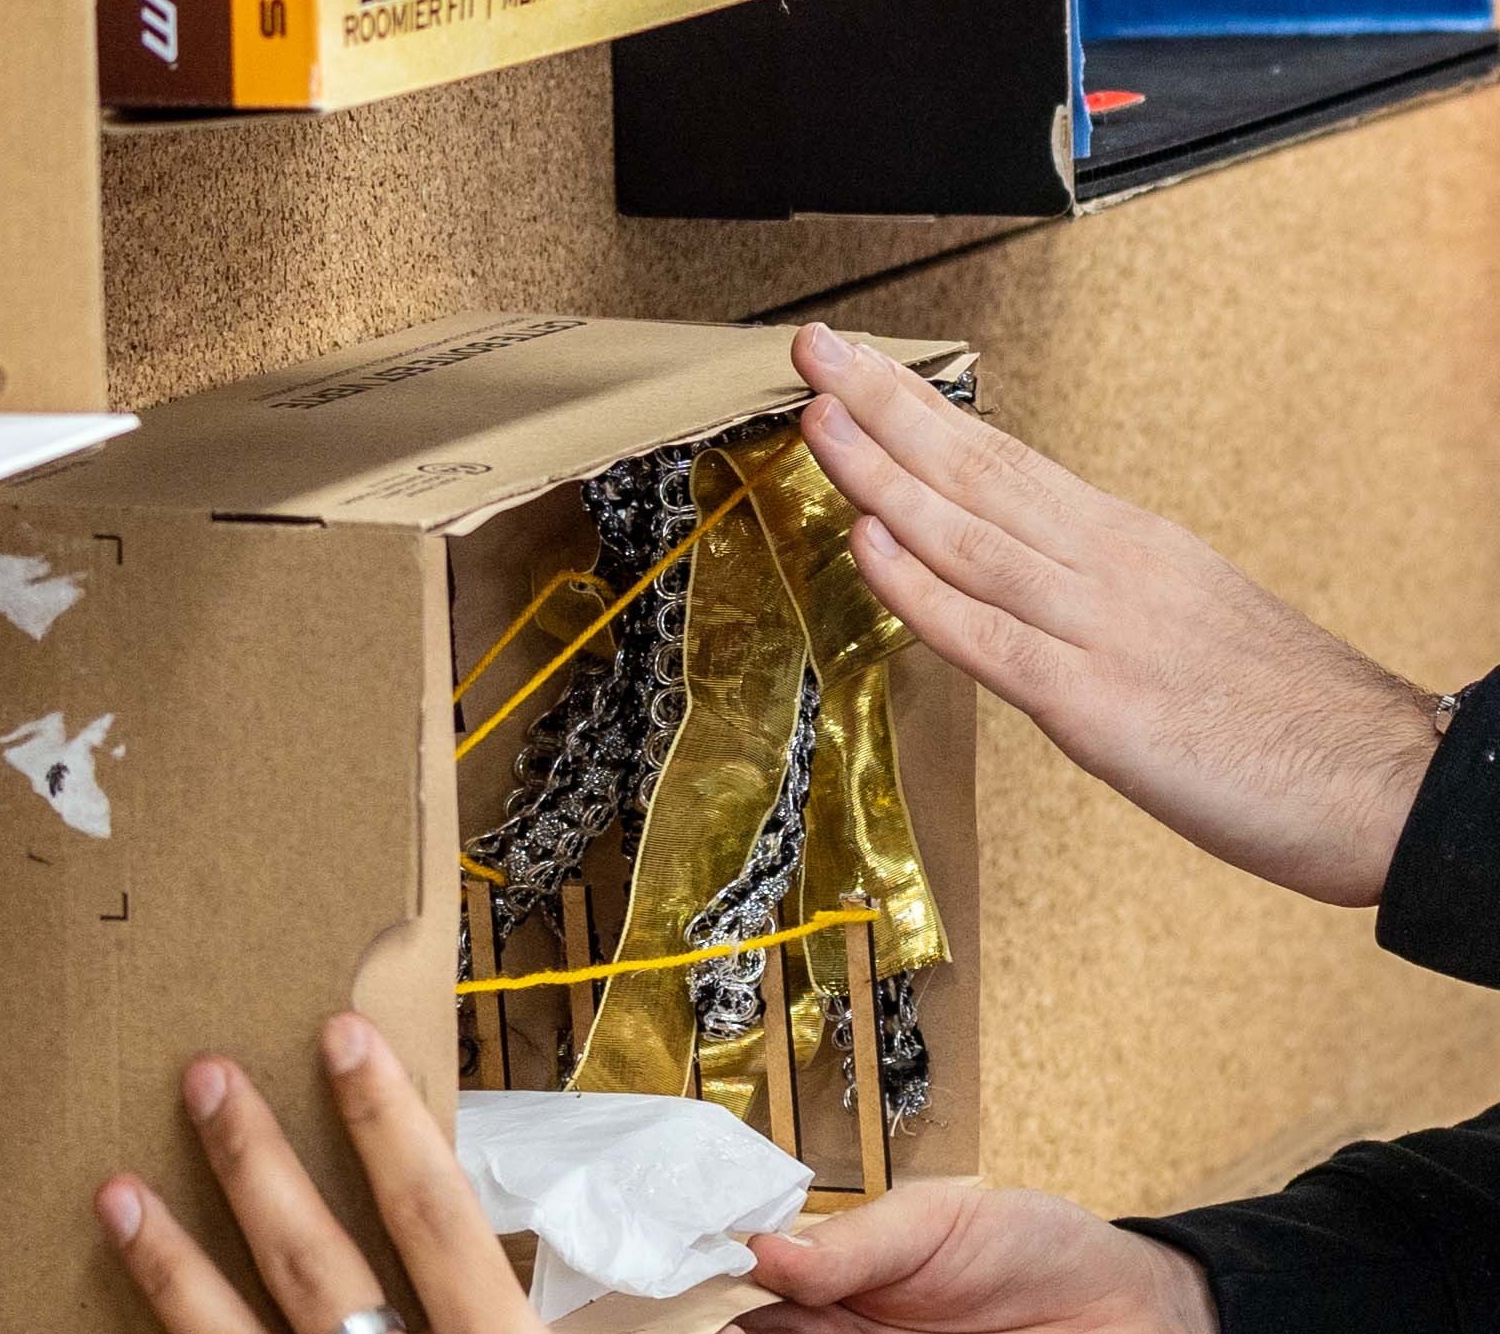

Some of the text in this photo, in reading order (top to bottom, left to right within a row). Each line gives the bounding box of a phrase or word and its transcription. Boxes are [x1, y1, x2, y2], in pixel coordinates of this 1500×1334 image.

[485, 319, 588, 343] CETTE
[359, 364, 436, 383] EST
[269, 381, 388, 410] VERTE
